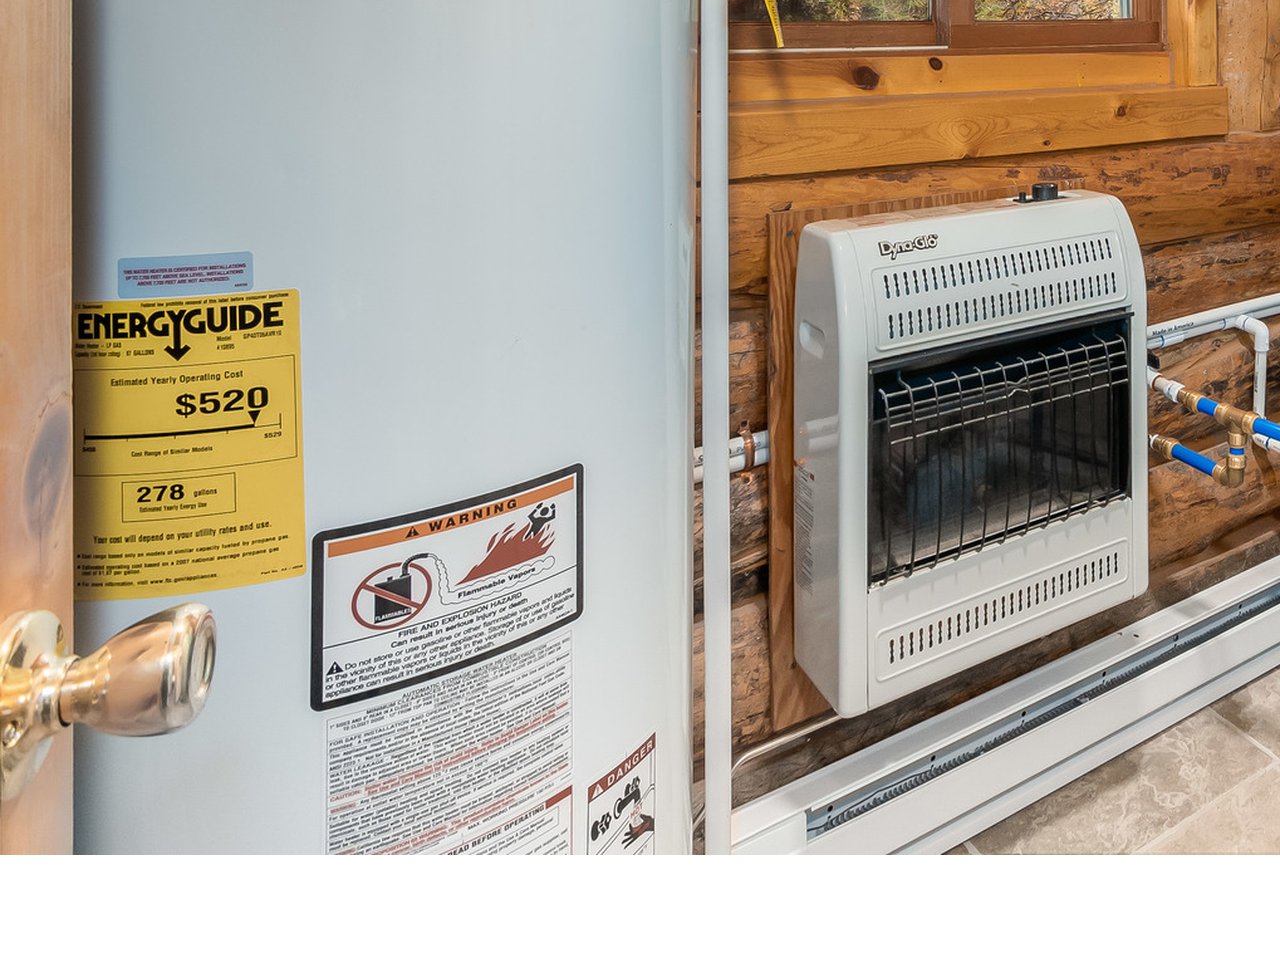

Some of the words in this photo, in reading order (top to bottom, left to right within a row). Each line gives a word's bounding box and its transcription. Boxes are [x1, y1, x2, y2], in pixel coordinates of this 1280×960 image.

[77, 301, 284, 340] ENERGYGUIDE
[1152, 328, 1167, 337] Made
[1174, 321, 1195, 332] America
[110, 377, 148, 387] Estimated
[151, 375, 177, 385] Yearly
[179, 372, 221, 384] Operating
[224, 370, 243, 379] Cost
[175, 386, 269, 418] $520
[144, 450, 162, 458] Range
[137, 484, 185, 503] 278
[193, 487, 217, 497] gallons
[139, 505, 162, 513] Estimated
[163, 504, 179, 512] Yearly
[429, 498, 519, 532] WARNING
[93, 536, 107, 544] Your
[109, 536, 122, 544] cost
[124, 535, 137, 543] will
[138, 533, 164, 544] depend
[166, 532, 174, 540] on
[177, 530, 193, 540] your
[195, 528, 217, 538] utility
[219, 526, 237, 535] rates
[239, 522, 253, 532] and
[256, 521, 272, 530] use.
[458, 579, 506, 599] Flammable
[508, 567, 536, 581] Vapors
[345, 662, 357, 670] Do
[359, 658, 371, 666] not
[373, 653, 393, 662] store
[405, 645, 419, 654] use
[421, 635, 452, 651] gasoline
[463, 624, 481, 635] other
[483, 610, 517, 628] flammable
[519, 602, 540, 614] vapors
[542, 595, 553, 605] and
[554, 587, 572, 599] liquids
[390, 639, 408, 648] Can
[410, 632, 434, 643] result
[445, 619, 474, 632] serious
[476, 611, 497, 623] injury
[509, 598, 528, 610] death
[398, 628, 418, 638] FIRE
[421, 621, 440, 632] AND
[442, 604, 489, 625] EXPLOSION
[490, 592, 522, 608] HAZARD
[325, 684, 364, 699] appliance
[366, 679, 382, 688] can
[383, 672, 404, 683] result
[415, 661, 442, 673] serious
[444, 652, 464, 665] injury
[474, 641, 495, 653] death.
[607, 739, 653, 788] DANGER
[471, 828, 502, 848] BEFORE
[504, 804, 545, 832] OPERATING
